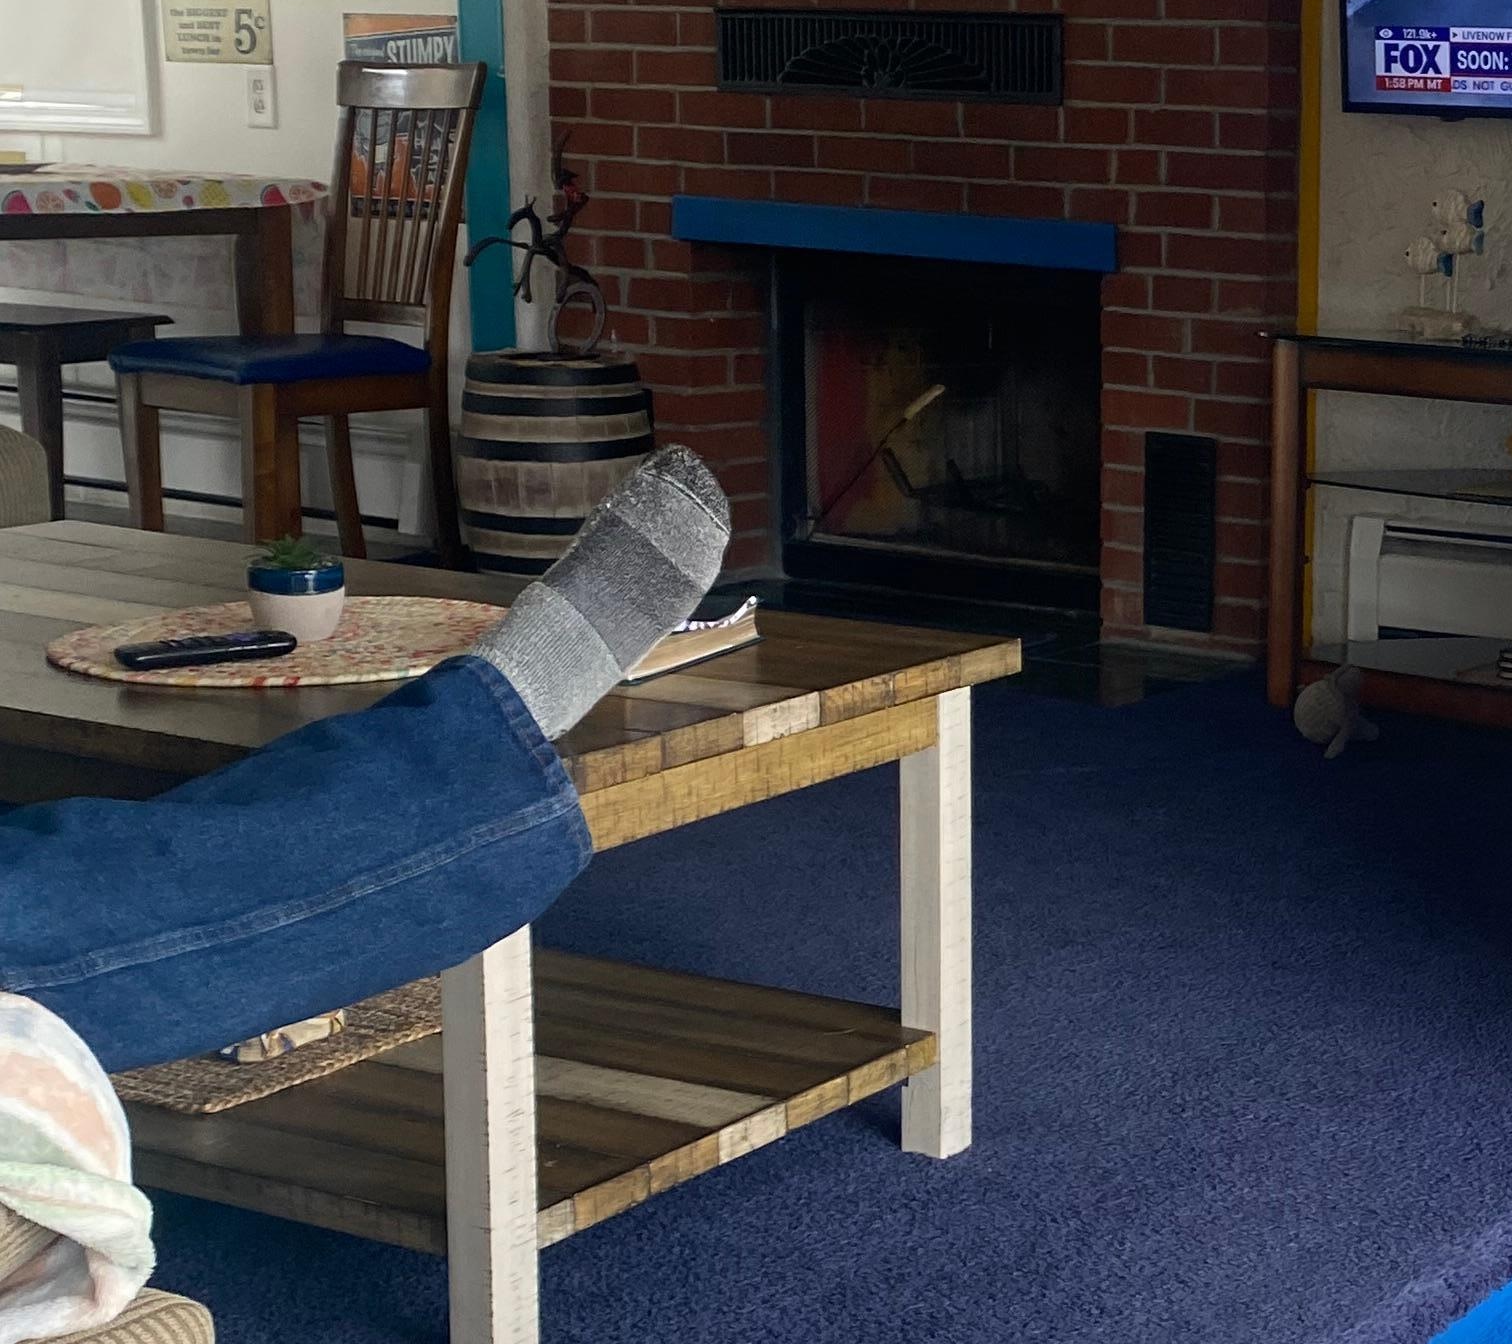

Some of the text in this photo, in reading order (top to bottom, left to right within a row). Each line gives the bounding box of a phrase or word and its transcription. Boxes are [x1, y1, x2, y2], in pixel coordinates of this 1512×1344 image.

[1462, 31, 1505, 41] LIVENOW
[387, 36, 454, 64] STUMPY
[1383, 42, 1443, 75] FOX
[1457, 50, 1509, 71] SOON:
[1407, 78, 1424, 89] PM
[1426, 79, 1442, 90] MT
[1472, 81, 1495, 91] NOT
